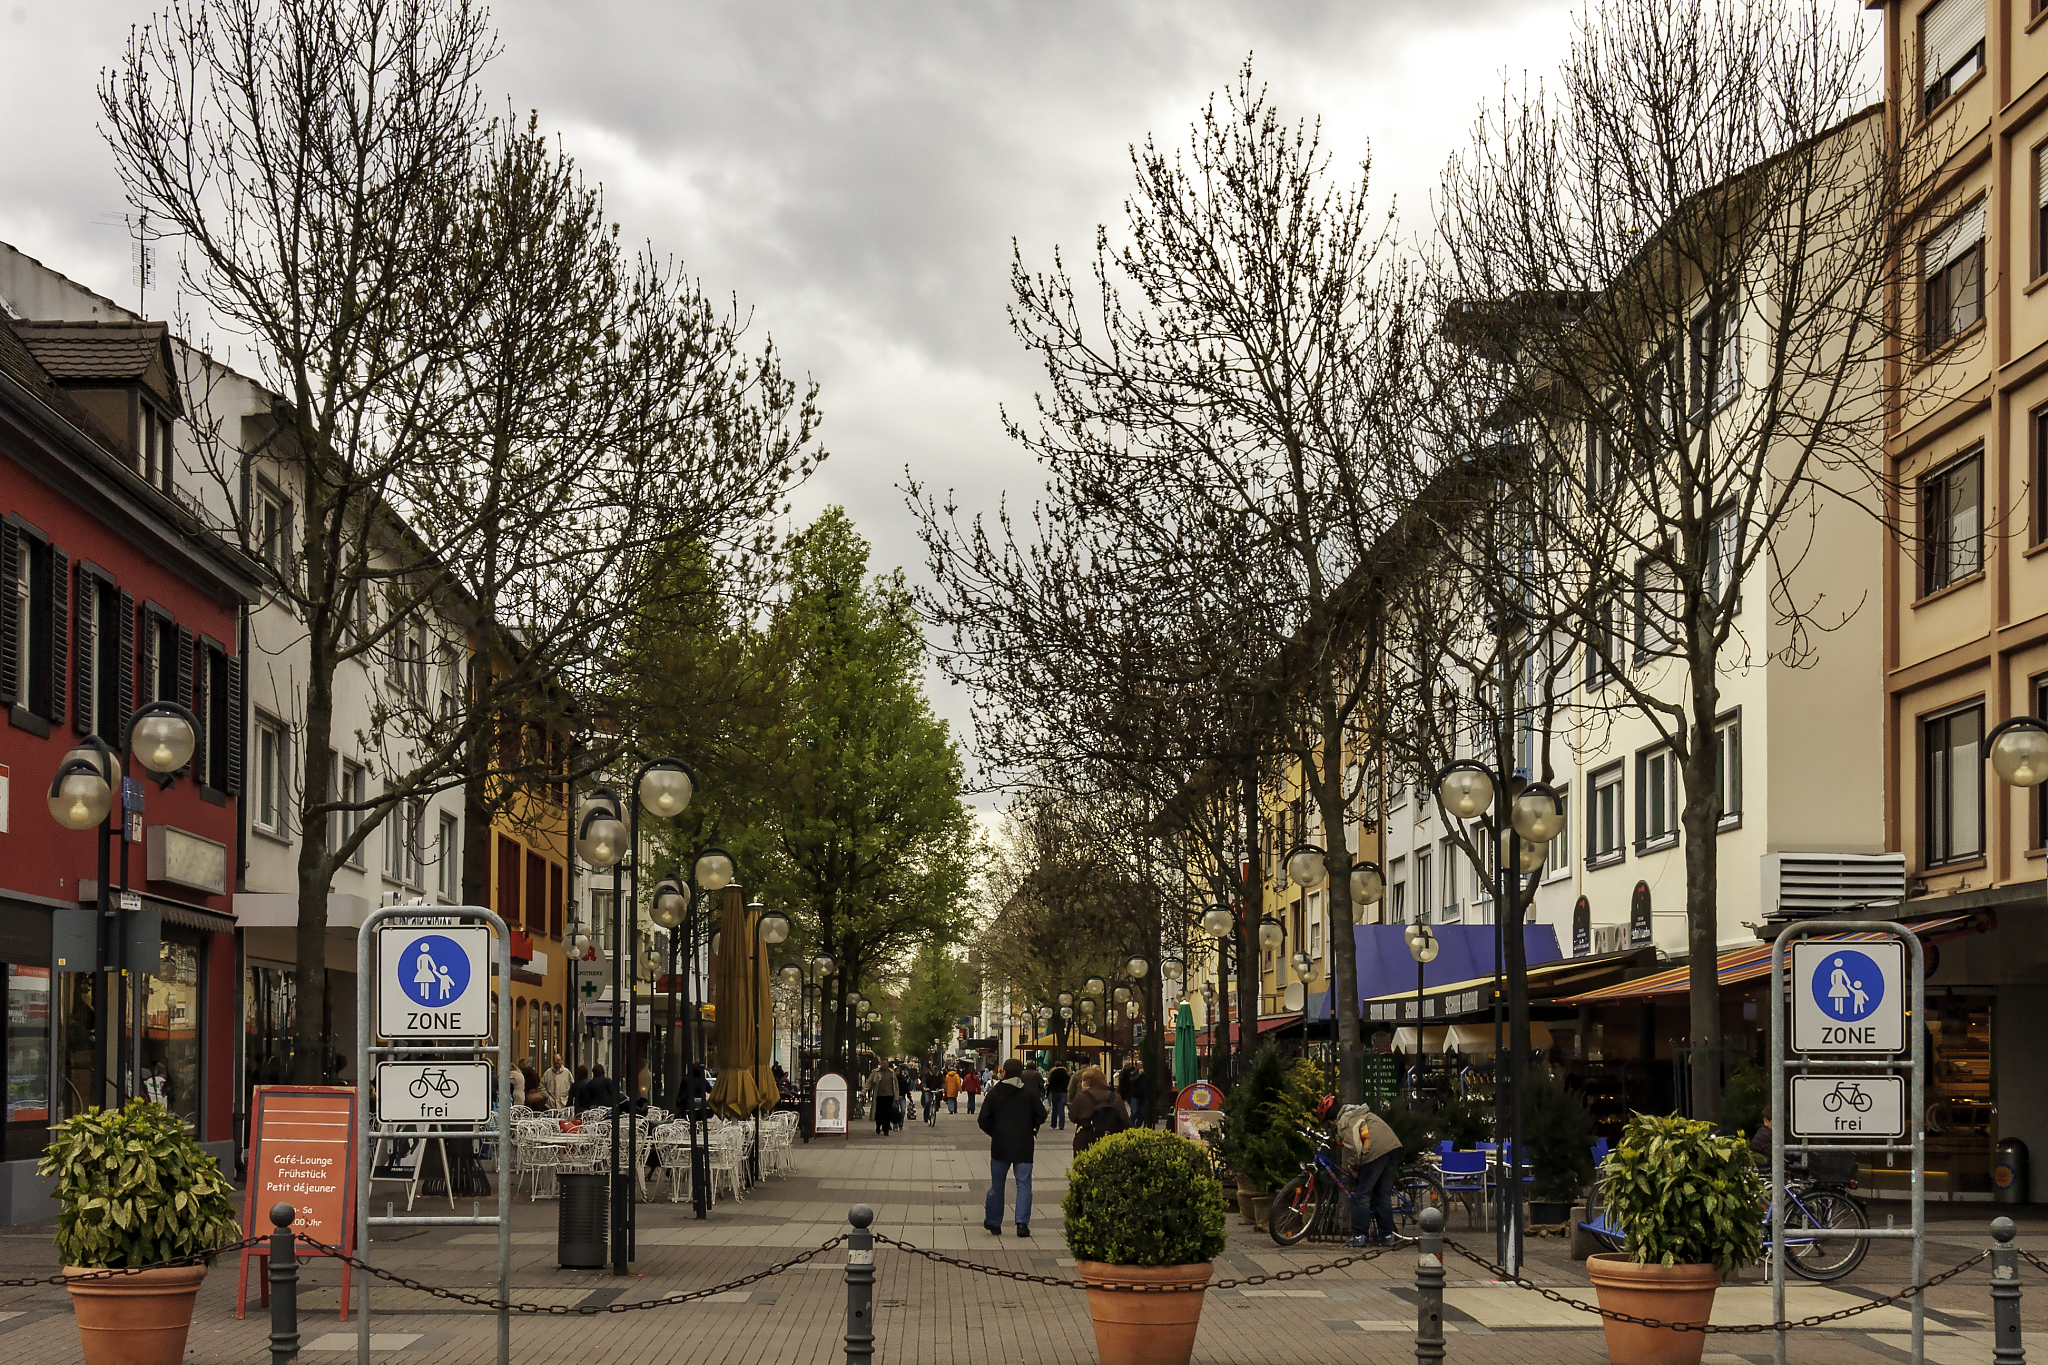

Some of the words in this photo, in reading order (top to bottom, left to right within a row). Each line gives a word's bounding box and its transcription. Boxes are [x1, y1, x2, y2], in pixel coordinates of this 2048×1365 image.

[407, 1012, 462, 1030] ZONE
[1821, 1027, 1876, 1044] ZONE
[420, 1103, 448, 1117] frei
[1834, 1117, 1862, 1130] frei
[273, 1154, 333, 1167] Café-Lounge
[278, 1168, 327, 1179] Frühstück
[266, 1182, 291, 1192] Petit
[293, 1182, 336, 1194] déjeuner
[302, 1206, 313, 1214] Sa
[306, 1218, 323, 1226] Uhr
